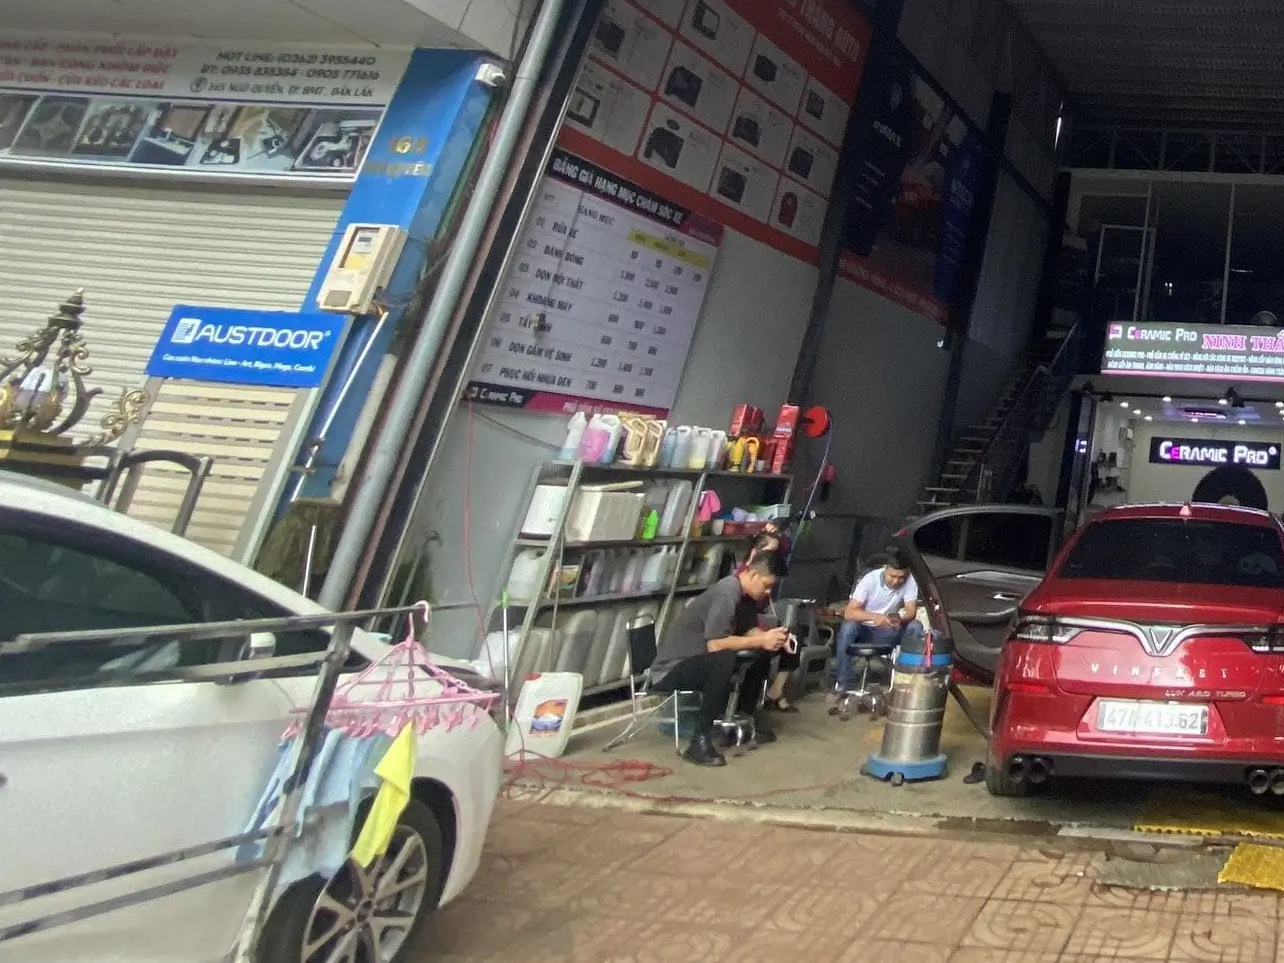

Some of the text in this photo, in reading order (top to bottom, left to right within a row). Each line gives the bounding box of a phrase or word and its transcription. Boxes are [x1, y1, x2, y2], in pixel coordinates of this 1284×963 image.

[195, 324, 324, 350] AUSTDOOR
[1201, 333, 1247, 352] NINH
[1159, 440, 1269, 465] CERAMIC PRO
